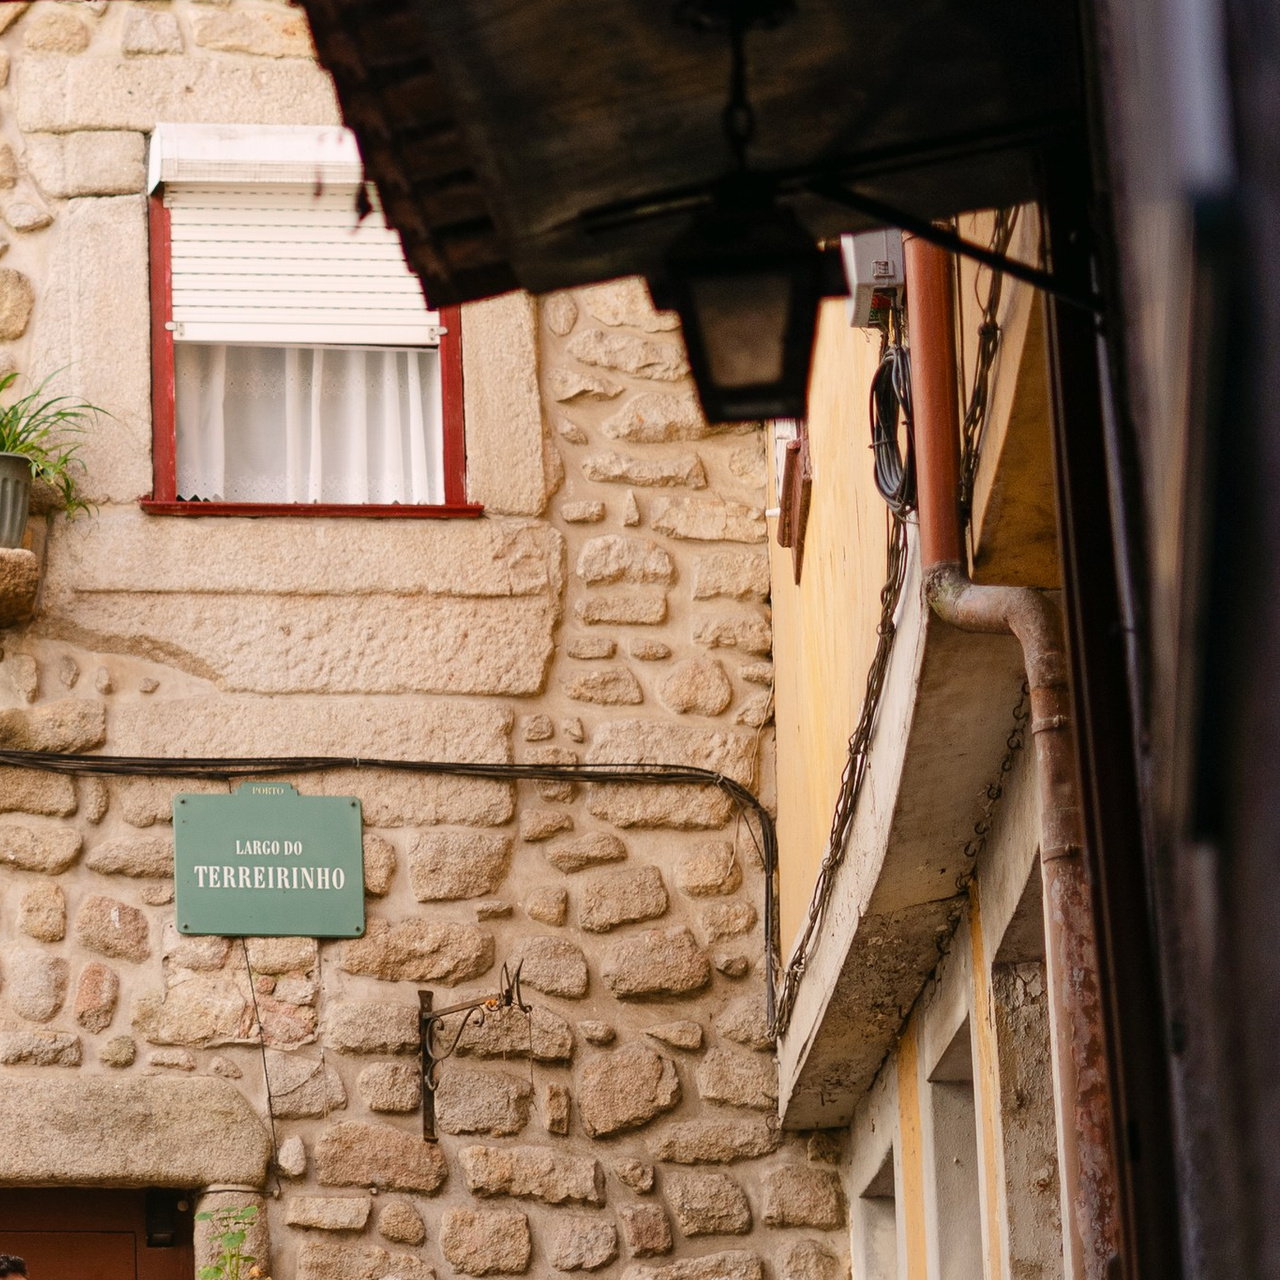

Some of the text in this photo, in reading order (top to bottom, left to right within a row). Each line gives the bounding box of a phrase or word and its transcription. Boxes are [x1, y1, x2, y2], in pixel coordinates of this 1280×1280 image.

[252, 786, 284, 795] PORTO
[236, 840, 302, 856] LARGO DO
[194, 865, 345, 890] TERREIRINHO
